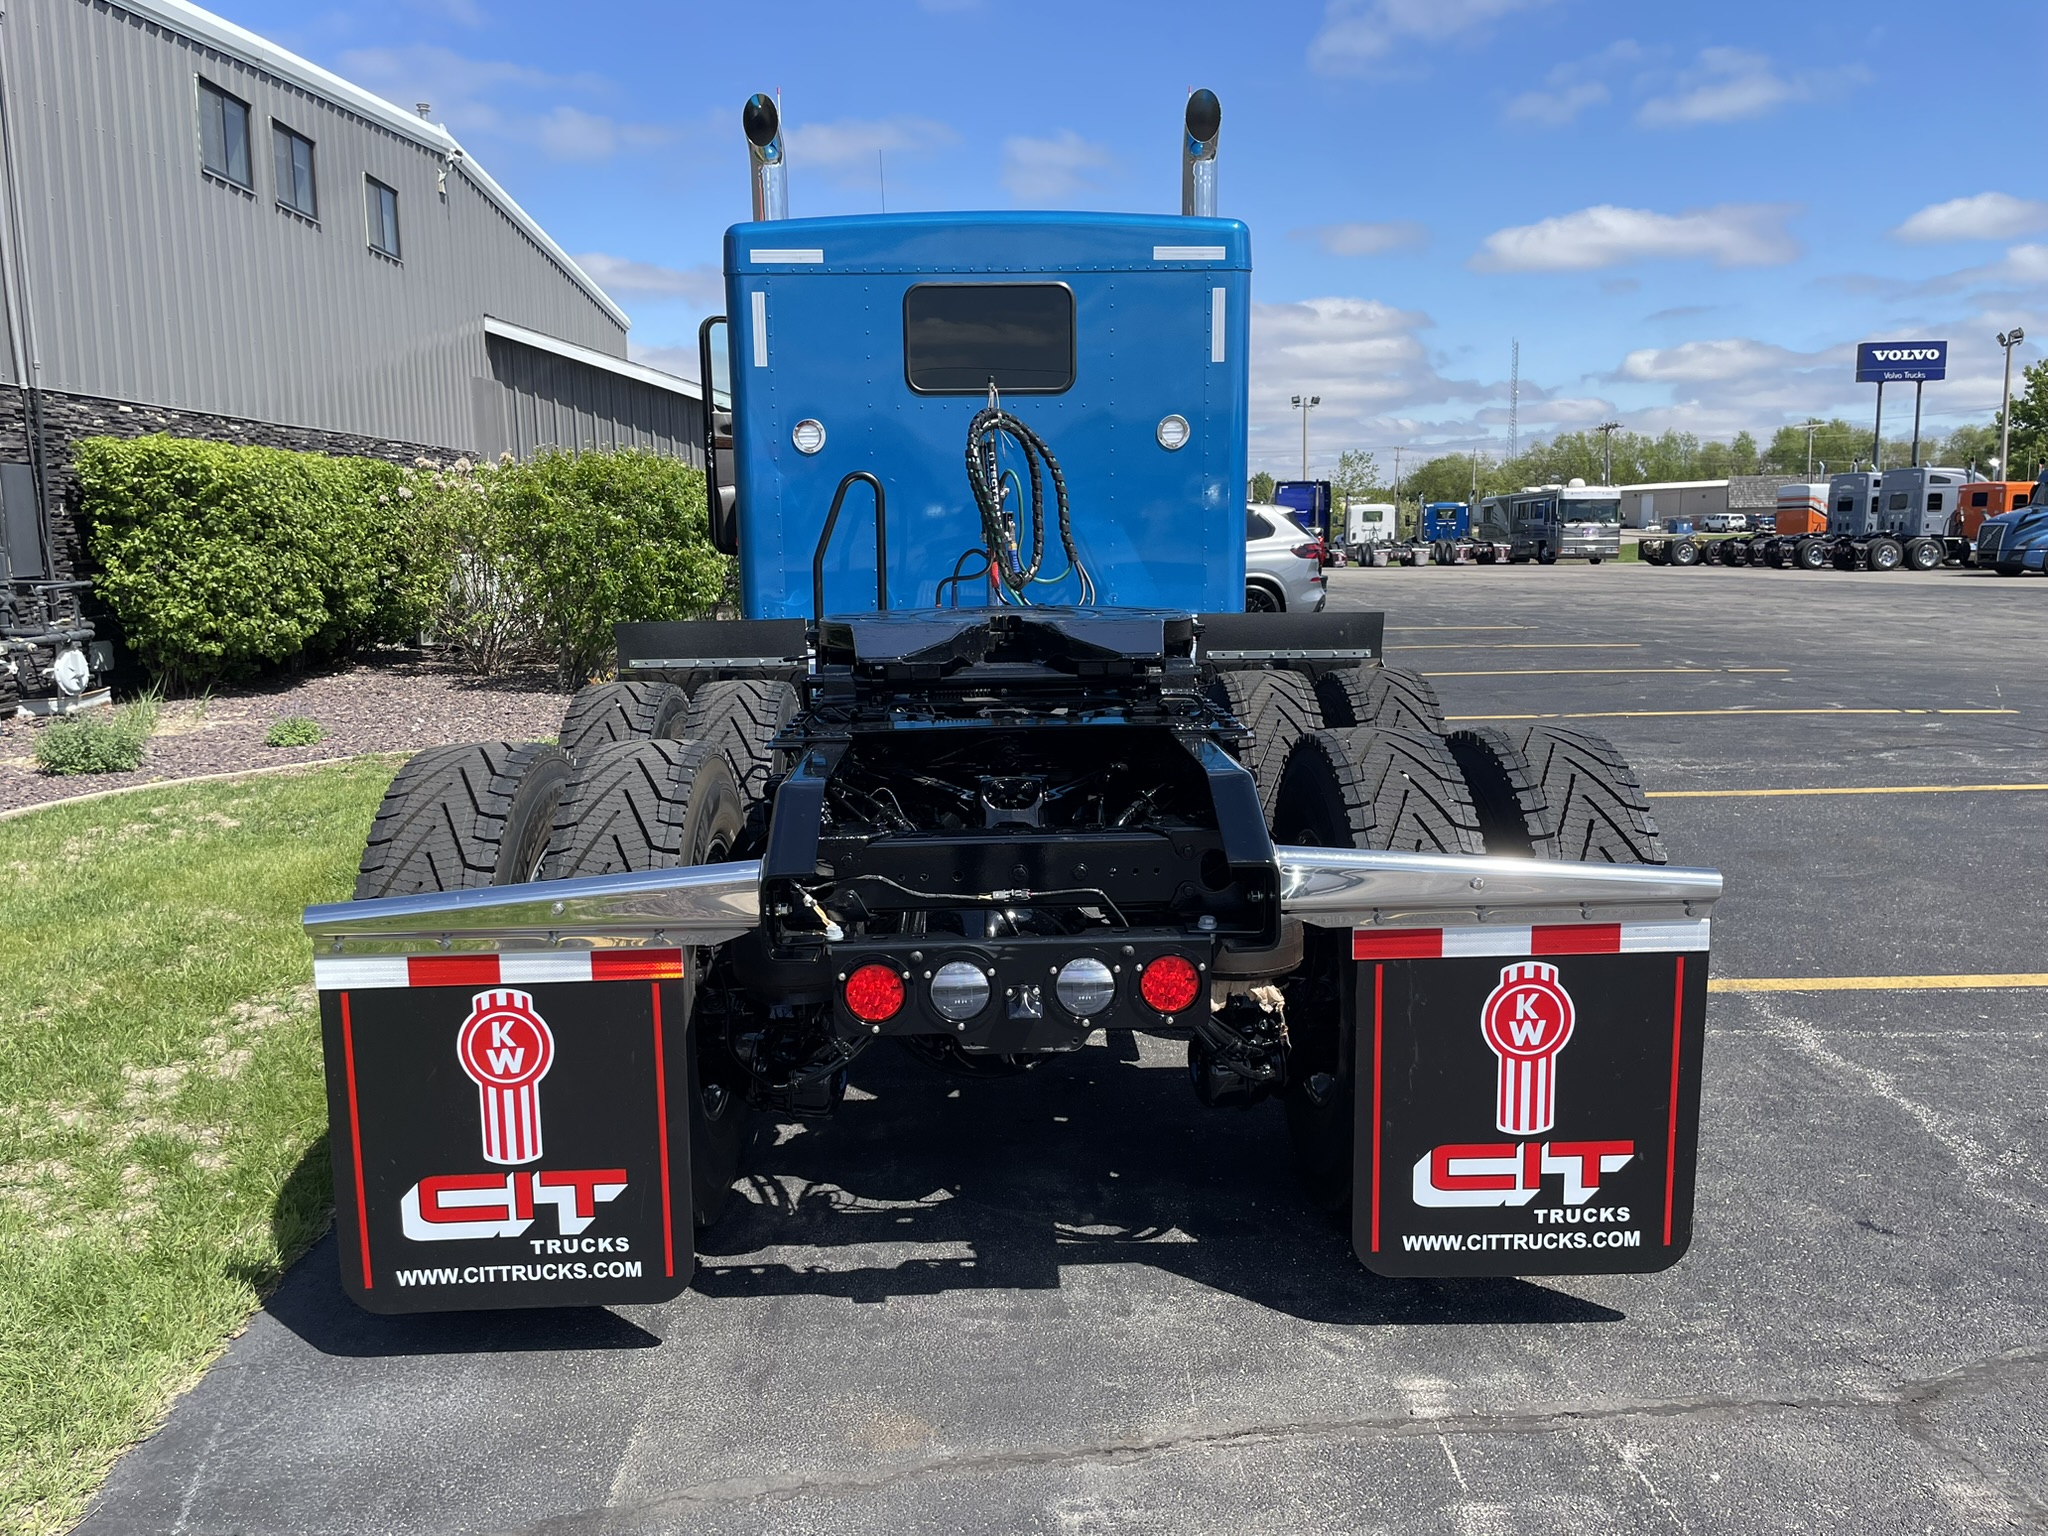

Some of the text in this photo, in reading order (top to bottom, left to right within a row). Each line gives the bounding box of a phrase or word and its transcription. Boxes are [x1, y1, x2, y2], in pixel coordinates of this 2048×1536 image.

[1872, 349, 1940, 361] VOLVO
[1884, 371, 1926, 380] Volvo Trucks
[1413, 1140, 1635, 1208] CIT
[400, 1168, 629, 1242] CIT
[1533, 1206, 1631, 1224] TRUCKS
[530, 1236, 630, 1255] TRUCKS
[1402, 1230, 1641, 1251] WWW.CITTRUCKS.COM
[396, 1260, 643, 1287] WWW.CITTRUCKS.COM
